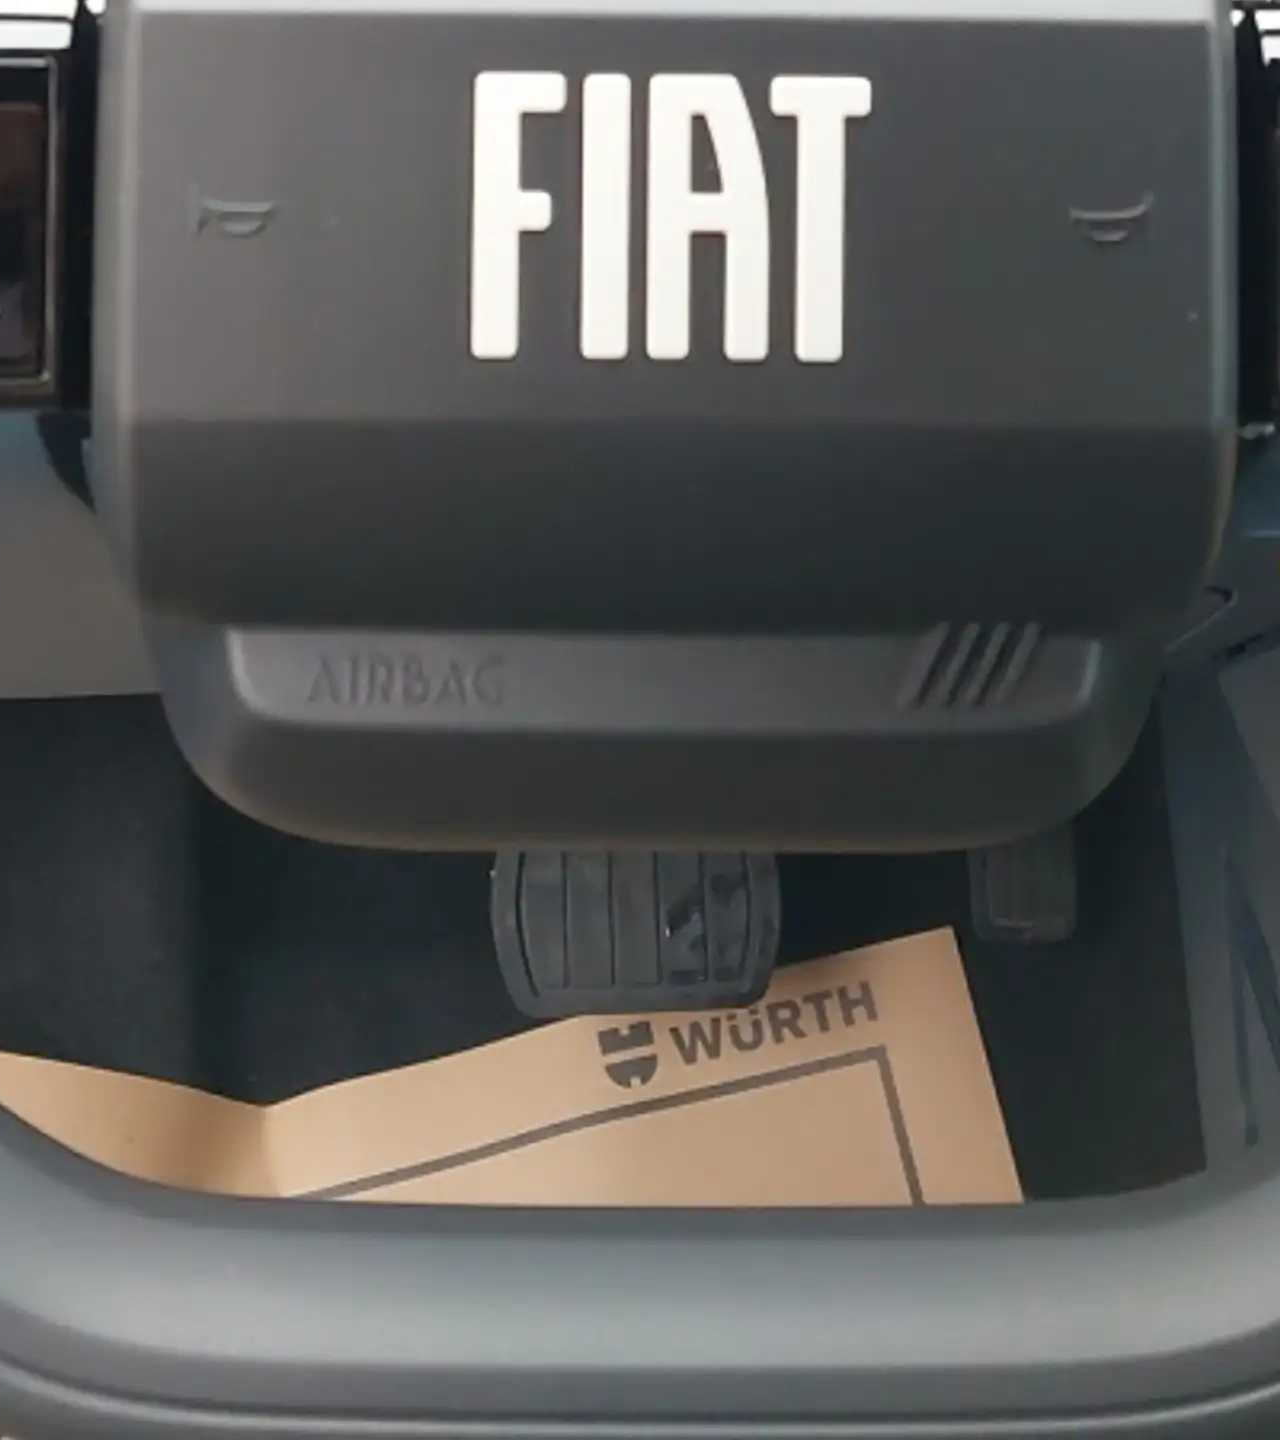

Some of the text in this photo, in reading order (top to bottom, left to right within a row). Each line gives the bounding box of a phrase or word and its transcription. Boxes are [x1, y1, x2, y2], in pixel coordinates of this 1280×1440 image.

[469, 70, 873, 363] FIAT
[306, 652, 508, 706] AIRBAG
[668, 980, 879, 1065] WÜRTH
